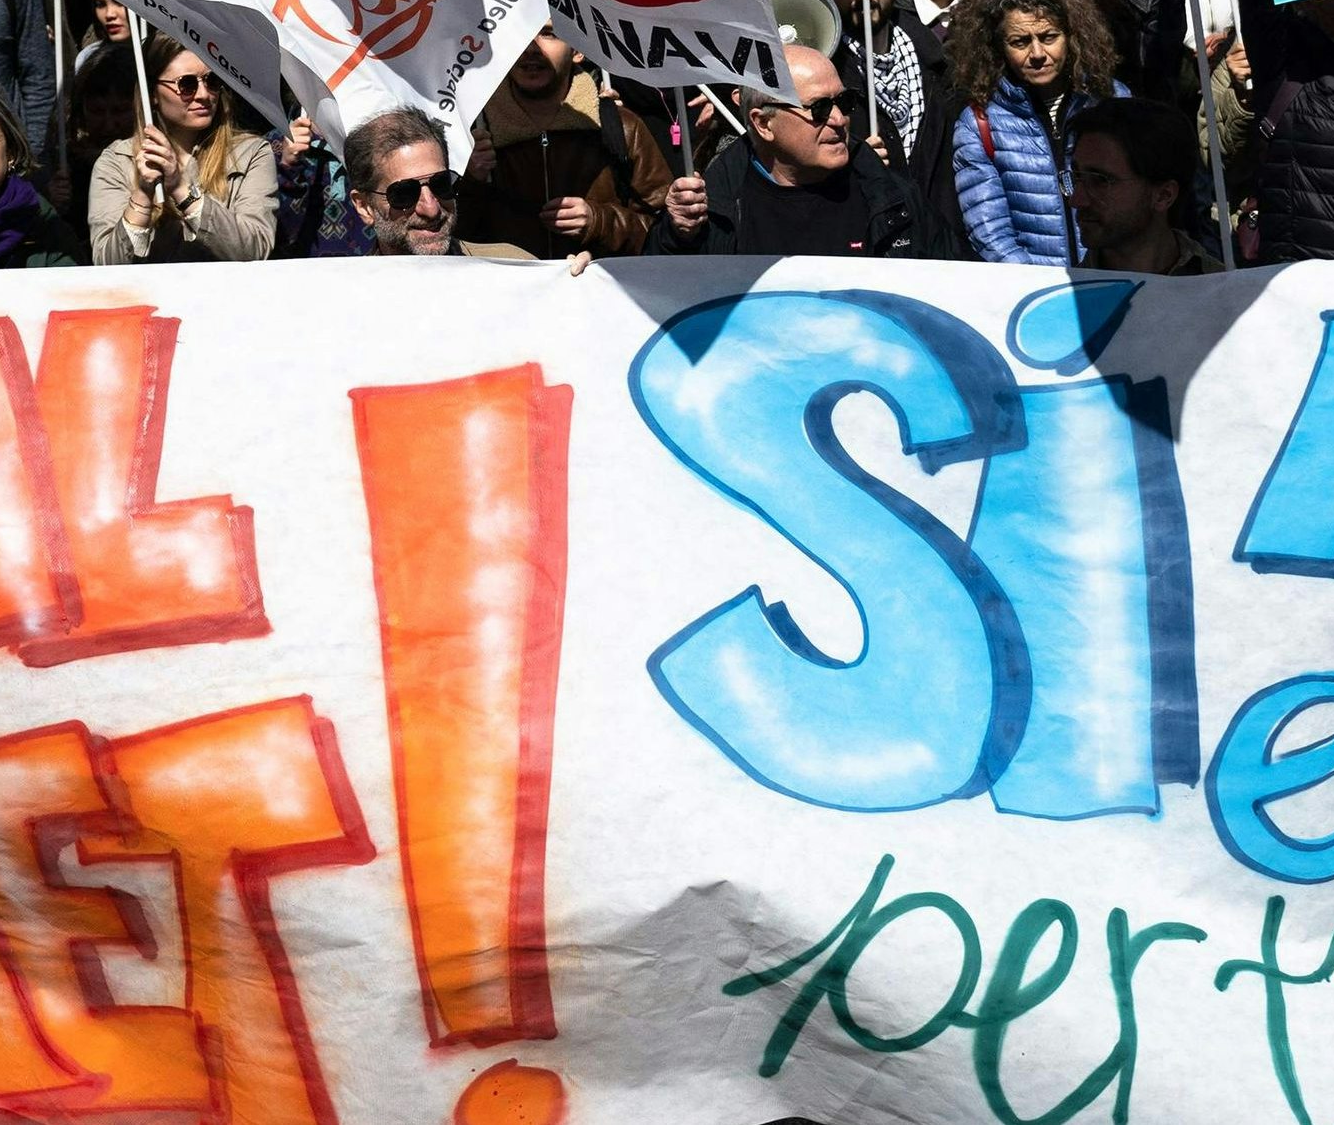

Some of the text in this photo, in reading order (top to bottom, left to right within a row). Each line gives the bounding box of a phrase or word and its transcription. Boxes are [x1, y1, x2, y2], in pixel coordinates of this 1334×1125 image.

[182, 19, 201, 44] la
[206, 39, 253, 89] Casa
[589, 5, 780, 89] NAVI
[721, 853, 1207, 1125] per
